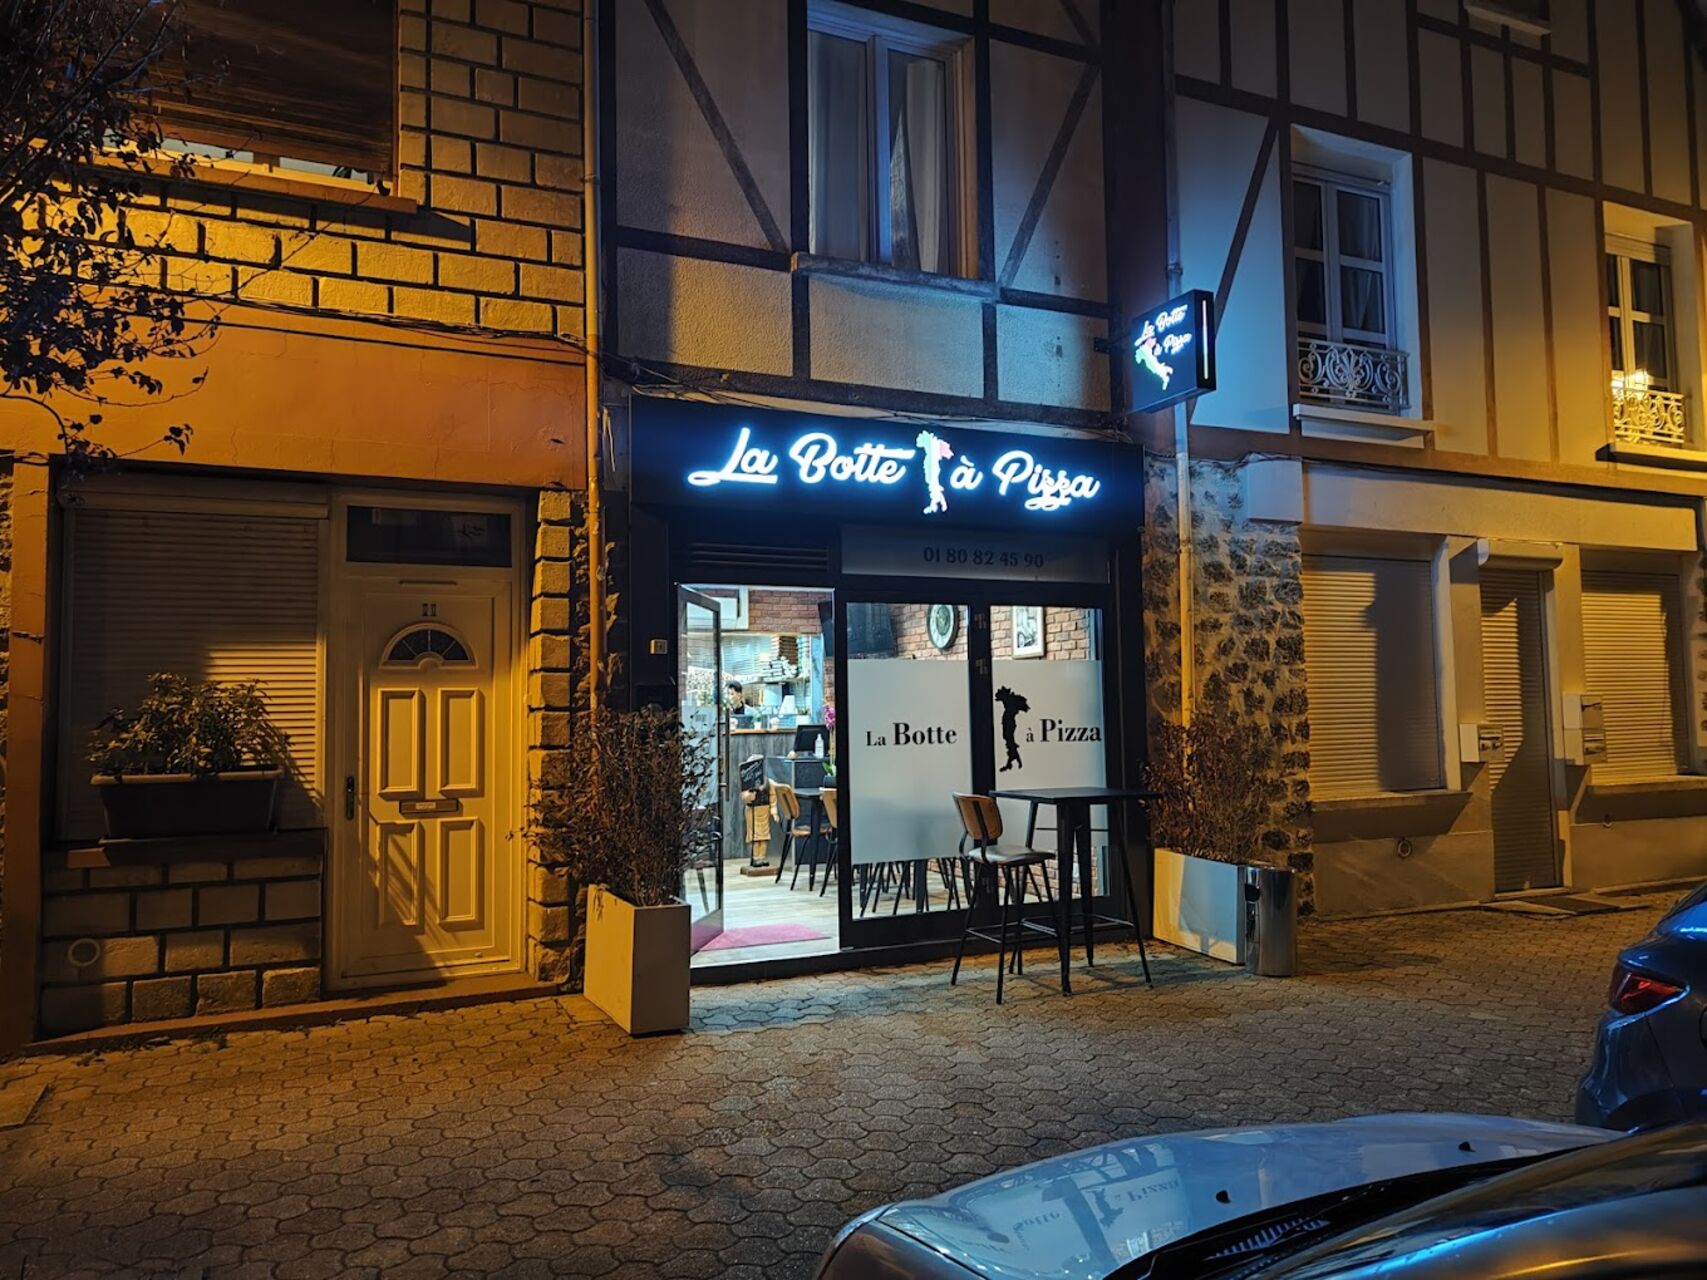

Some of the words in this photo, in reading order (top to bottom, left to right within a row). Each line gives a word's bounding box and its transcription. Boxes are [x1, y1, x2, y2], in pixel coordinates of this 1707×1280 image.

[1134, 320, 1156, 347] La
[1155, 304, 1188, 332] Botte
[688, 427, 778, 487] La
[789, 431, 915, 485] Botte
[950, 455, 984, 490] à
[992, 450, 1100, 511] Pizza
[923, 546, 941, 563] 01
[946, 547, 968, 564] 80
[973, 549, 994, 566] 82
[999, 551, 1018, 567] 45
[1024, 552, 1043, 568] 90
[866, 731, 886, 746] La
[892, 722, 958, 746] Botte
[1026, 728, 1035, 743] à
[1040, 718, 1102, 743] Pizza
